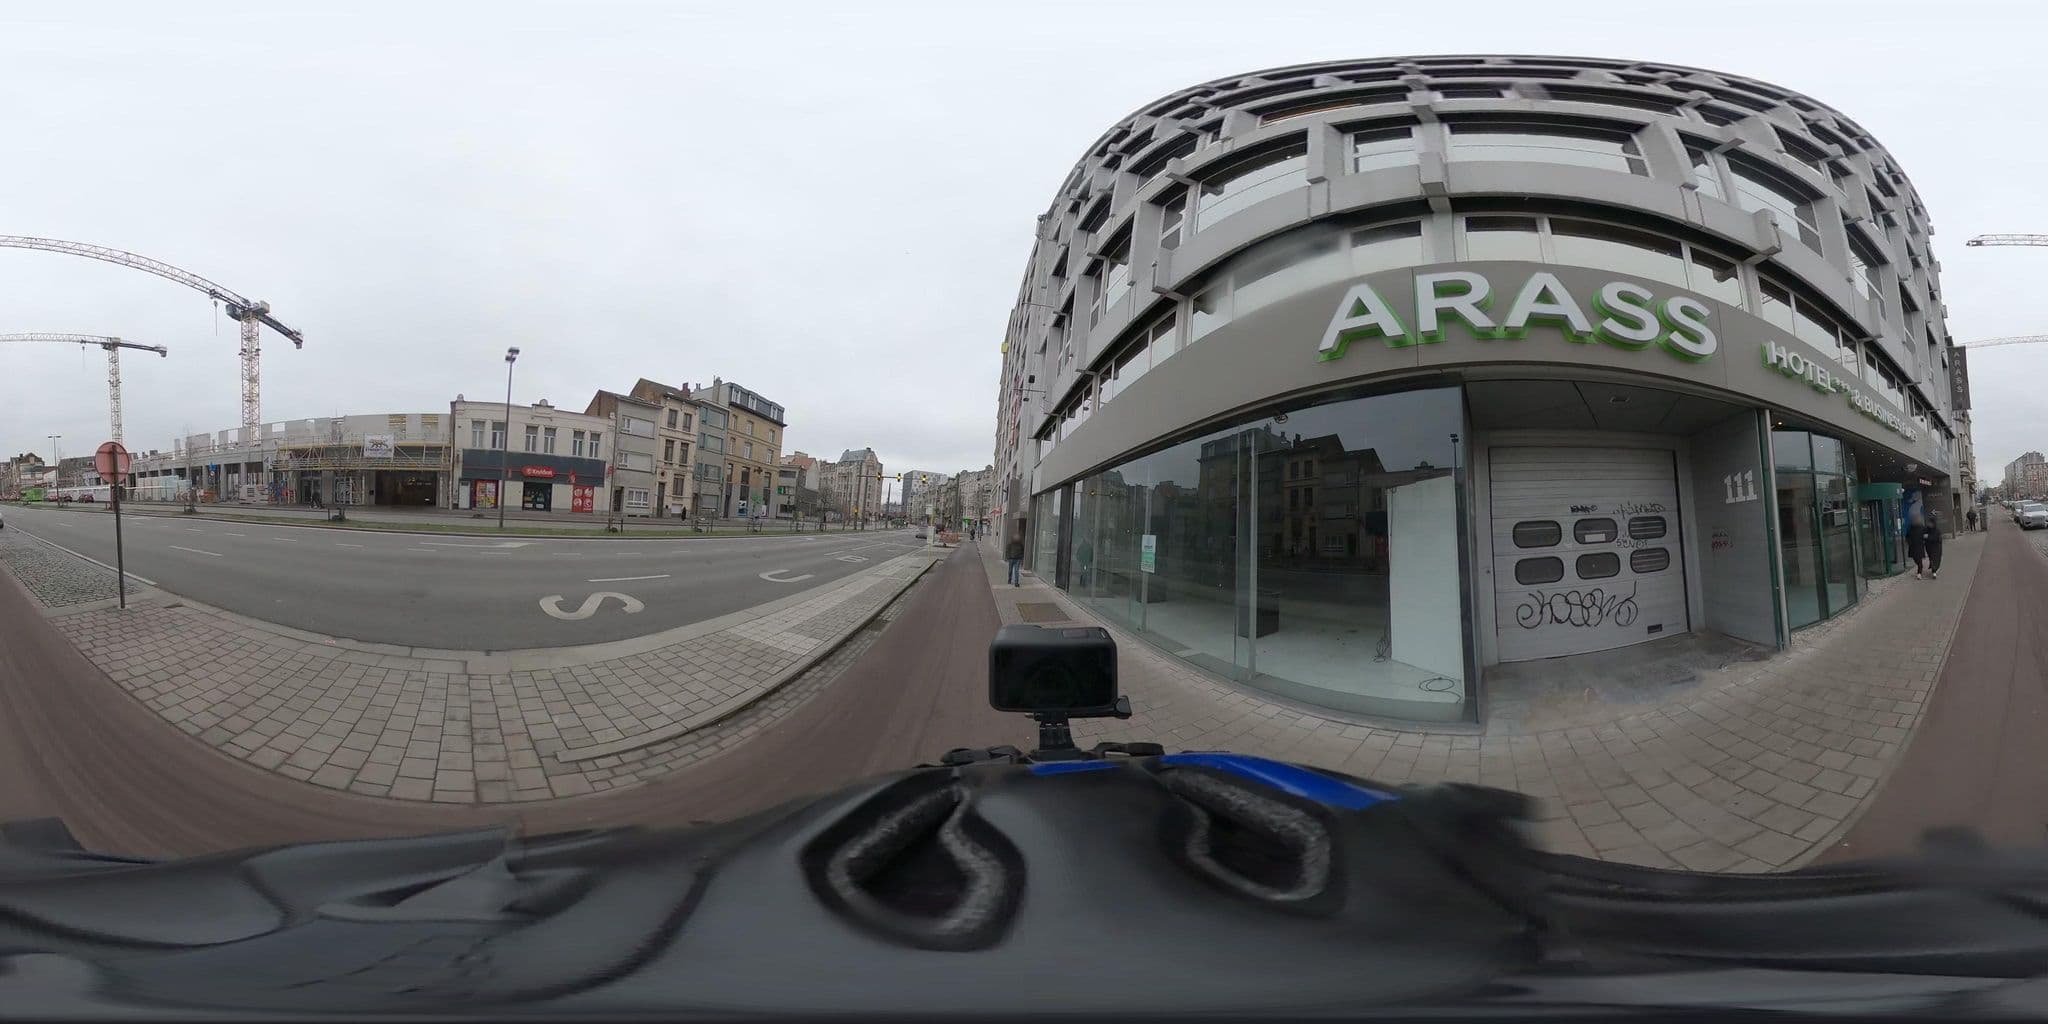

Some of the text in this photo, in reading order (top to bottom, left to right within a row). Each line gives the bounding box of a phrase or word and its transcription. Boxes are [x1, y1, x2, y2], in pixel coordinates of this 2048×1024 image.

[1318, 271, 1718, 357] ARASS
[1765, 340, 1837, 393] HOTEL
[1953, 351, 1963, 393] ARASS
[1724, 469, 1758, 504] 111
